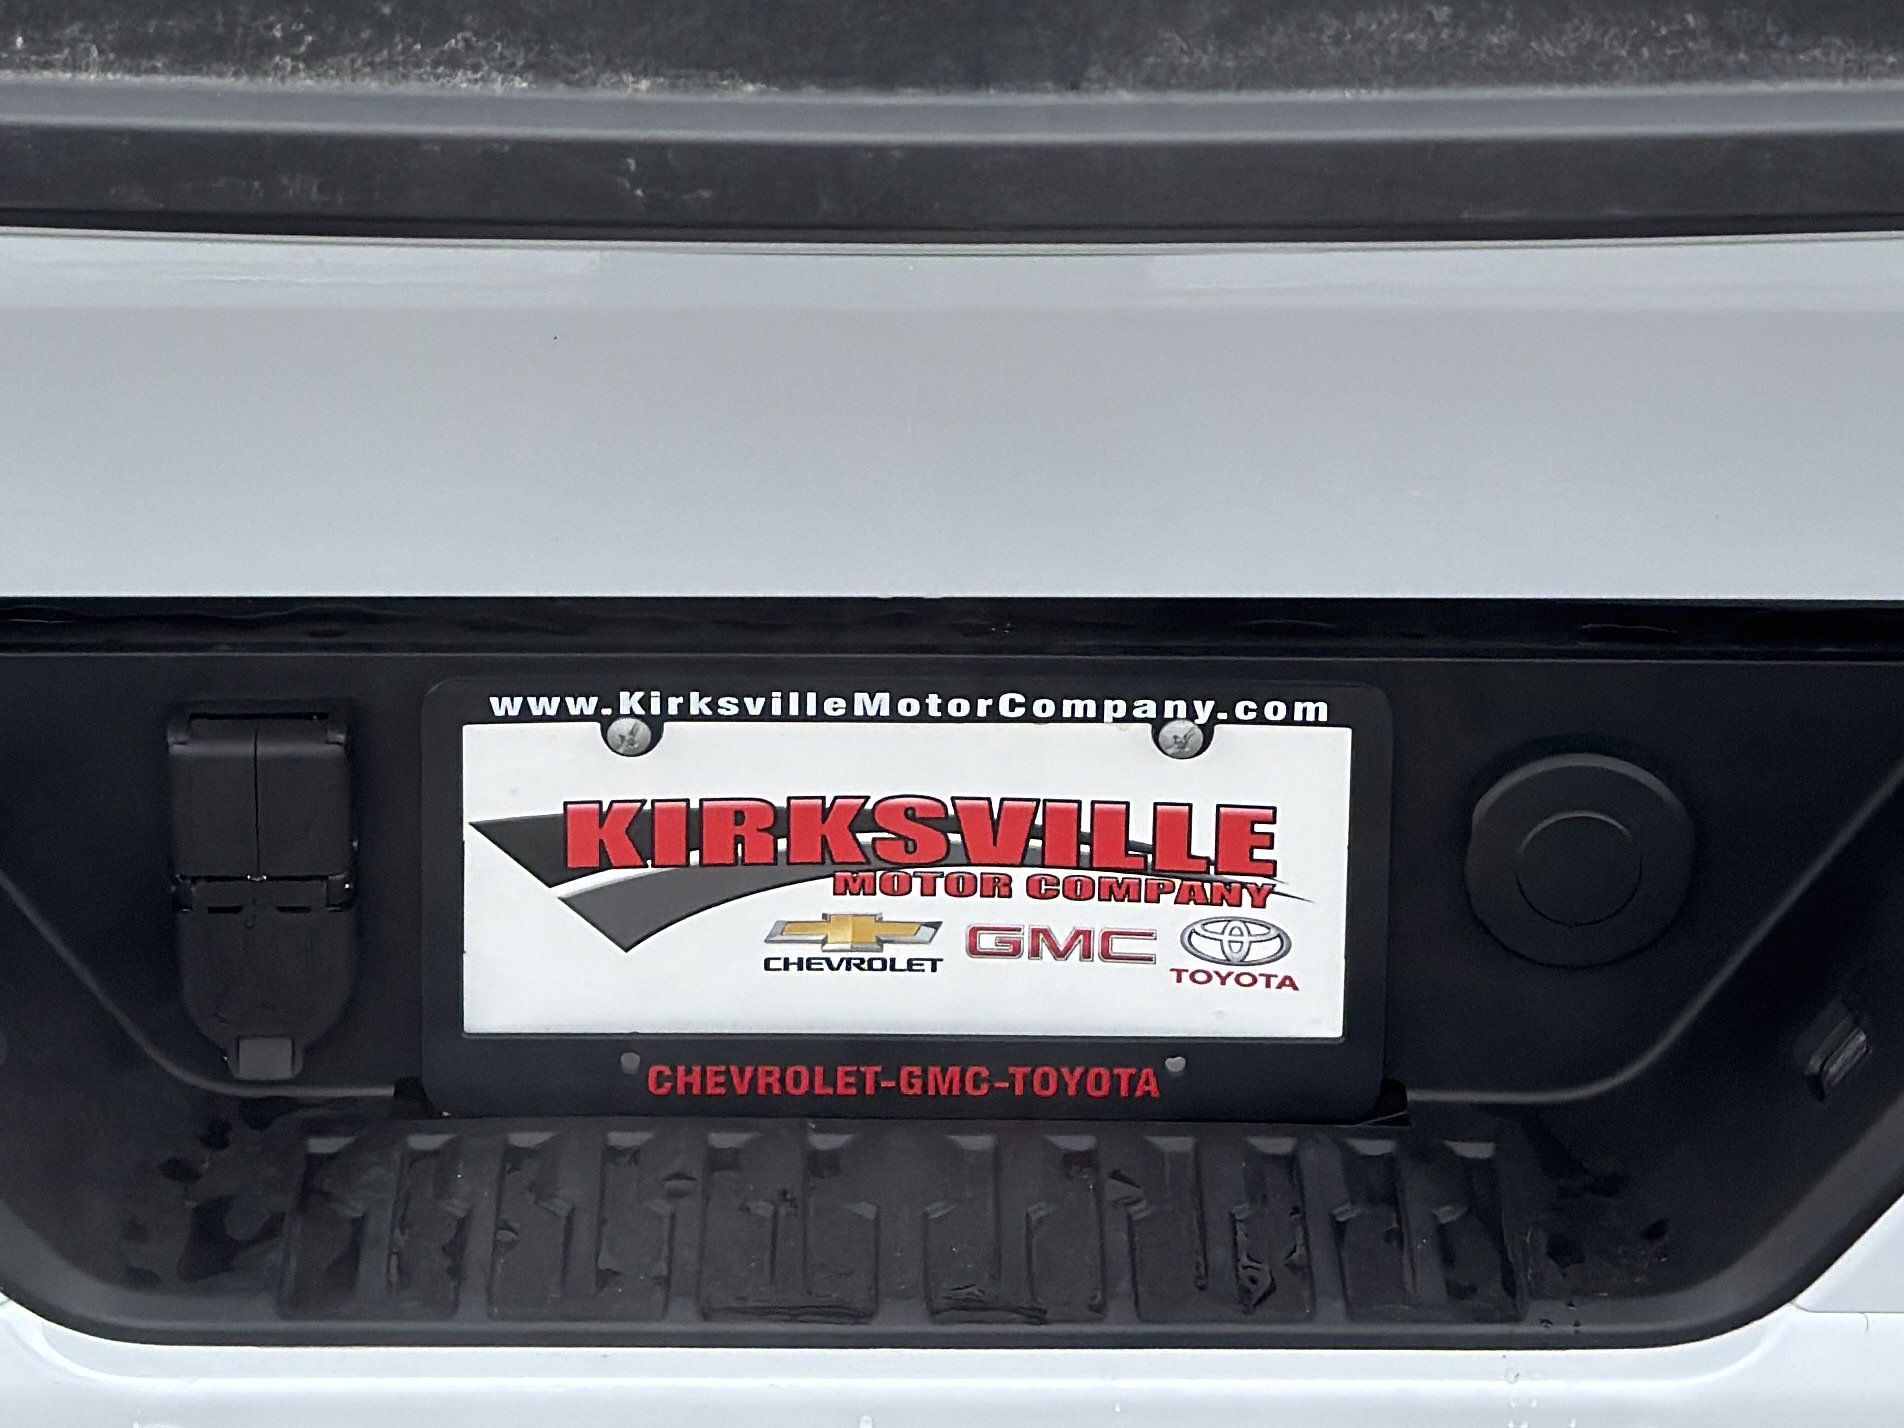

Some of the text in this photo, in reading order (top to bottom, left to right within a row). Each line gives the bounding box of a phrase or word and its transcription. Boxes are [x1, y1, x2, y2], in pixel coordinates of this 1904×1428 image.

[488, 690, 1329, 724] www.KirksvilleMotorCompany.com
[563, 794, 1278, 877] KIRKSVILLE
[832, 871, 1278, 909] MOTOR COMPANY
[965, 923, 1158, 965] GMC
[763, 956, 944, 973] CHEVROLET
[1169, 967, 1300, 992] TOYOTA
[646, 1064, 1161, 1099] CHEVROLET-GMC-TOYOTA
